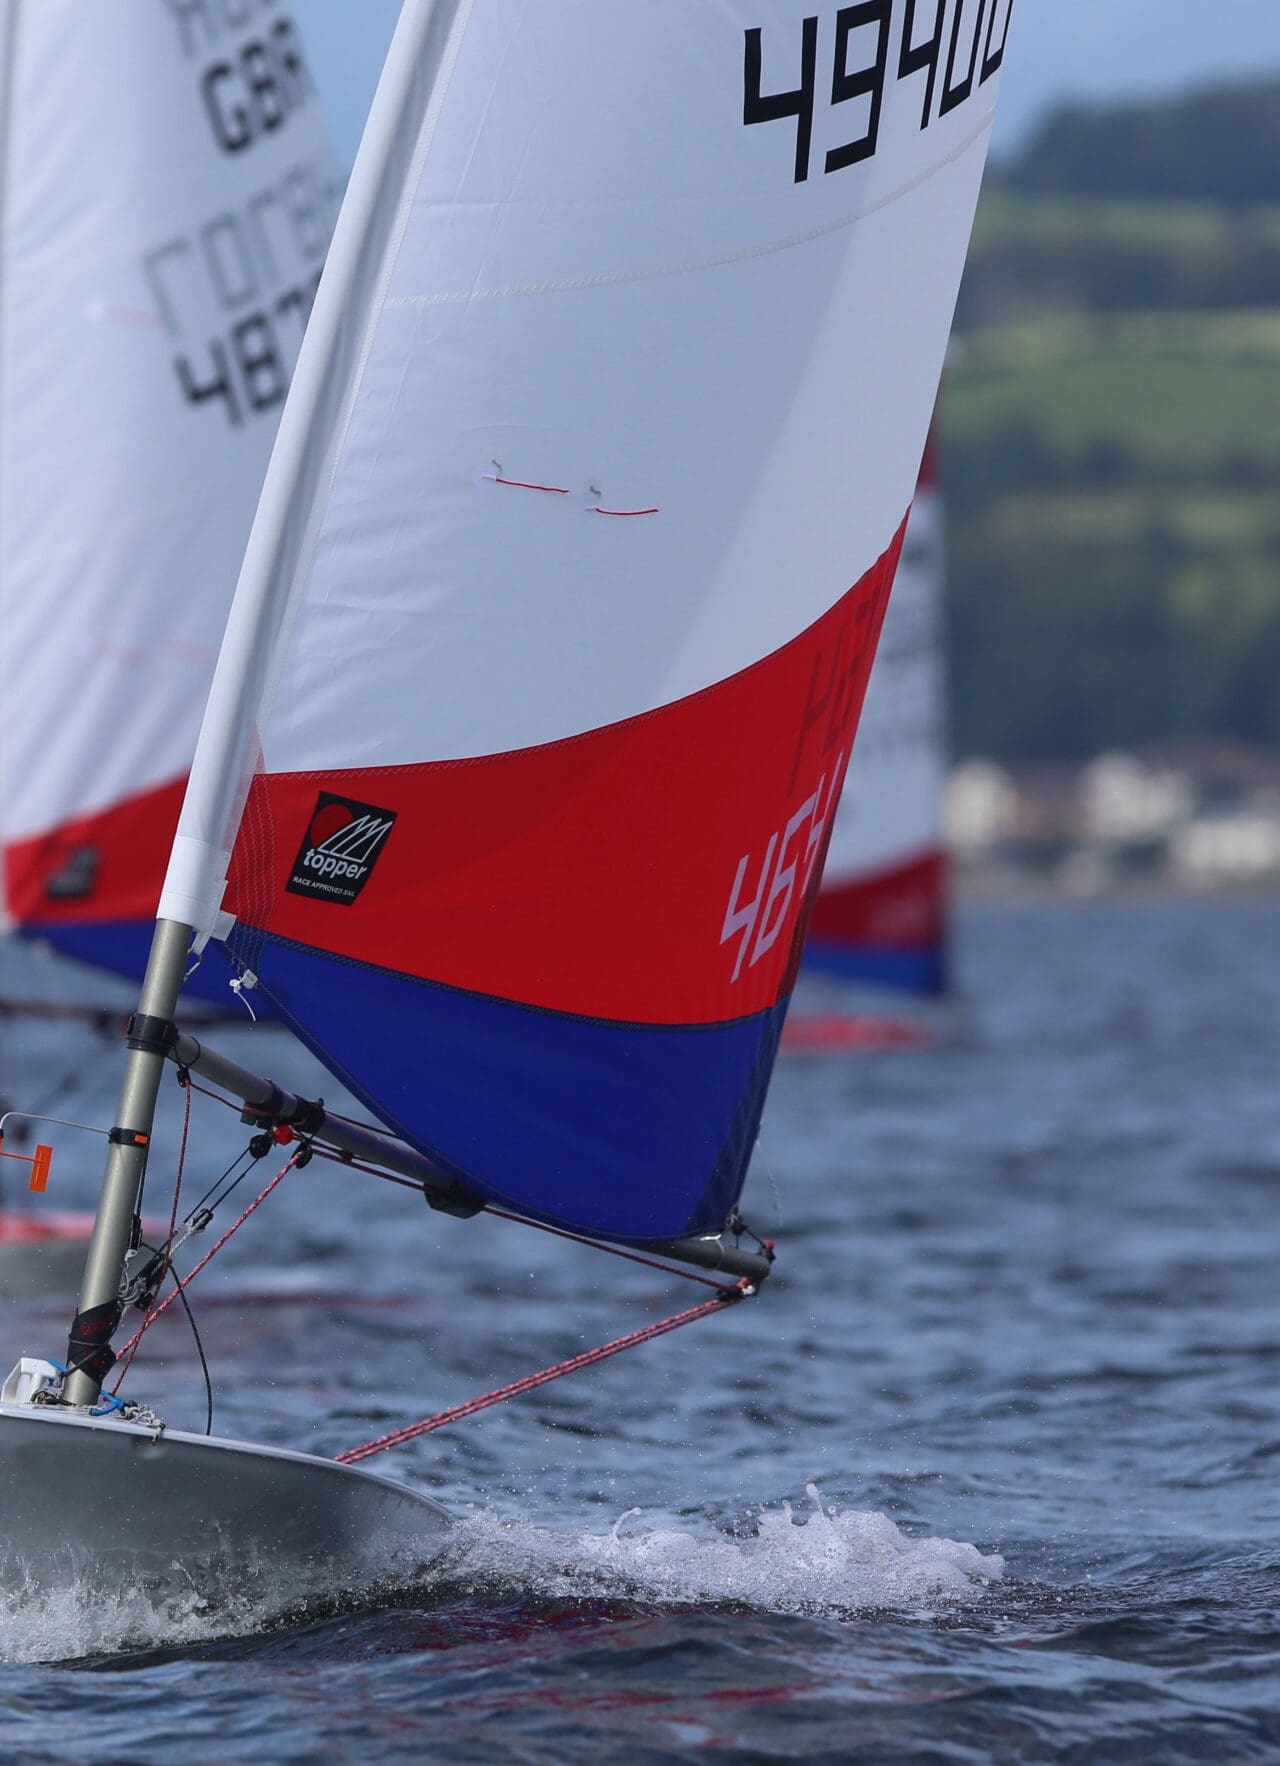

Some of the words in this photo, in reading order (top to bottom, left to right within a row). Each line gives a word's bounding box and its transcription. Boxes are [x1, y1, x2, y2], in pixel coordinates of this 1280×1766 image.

[175, 268, 323, 428] 487
[303, 848, 368, 880] topper
[293, 876, 311, 887] RACE
[311, 881, 343, 894] APPROVED
[342, 889, 356, 897] SAIL
